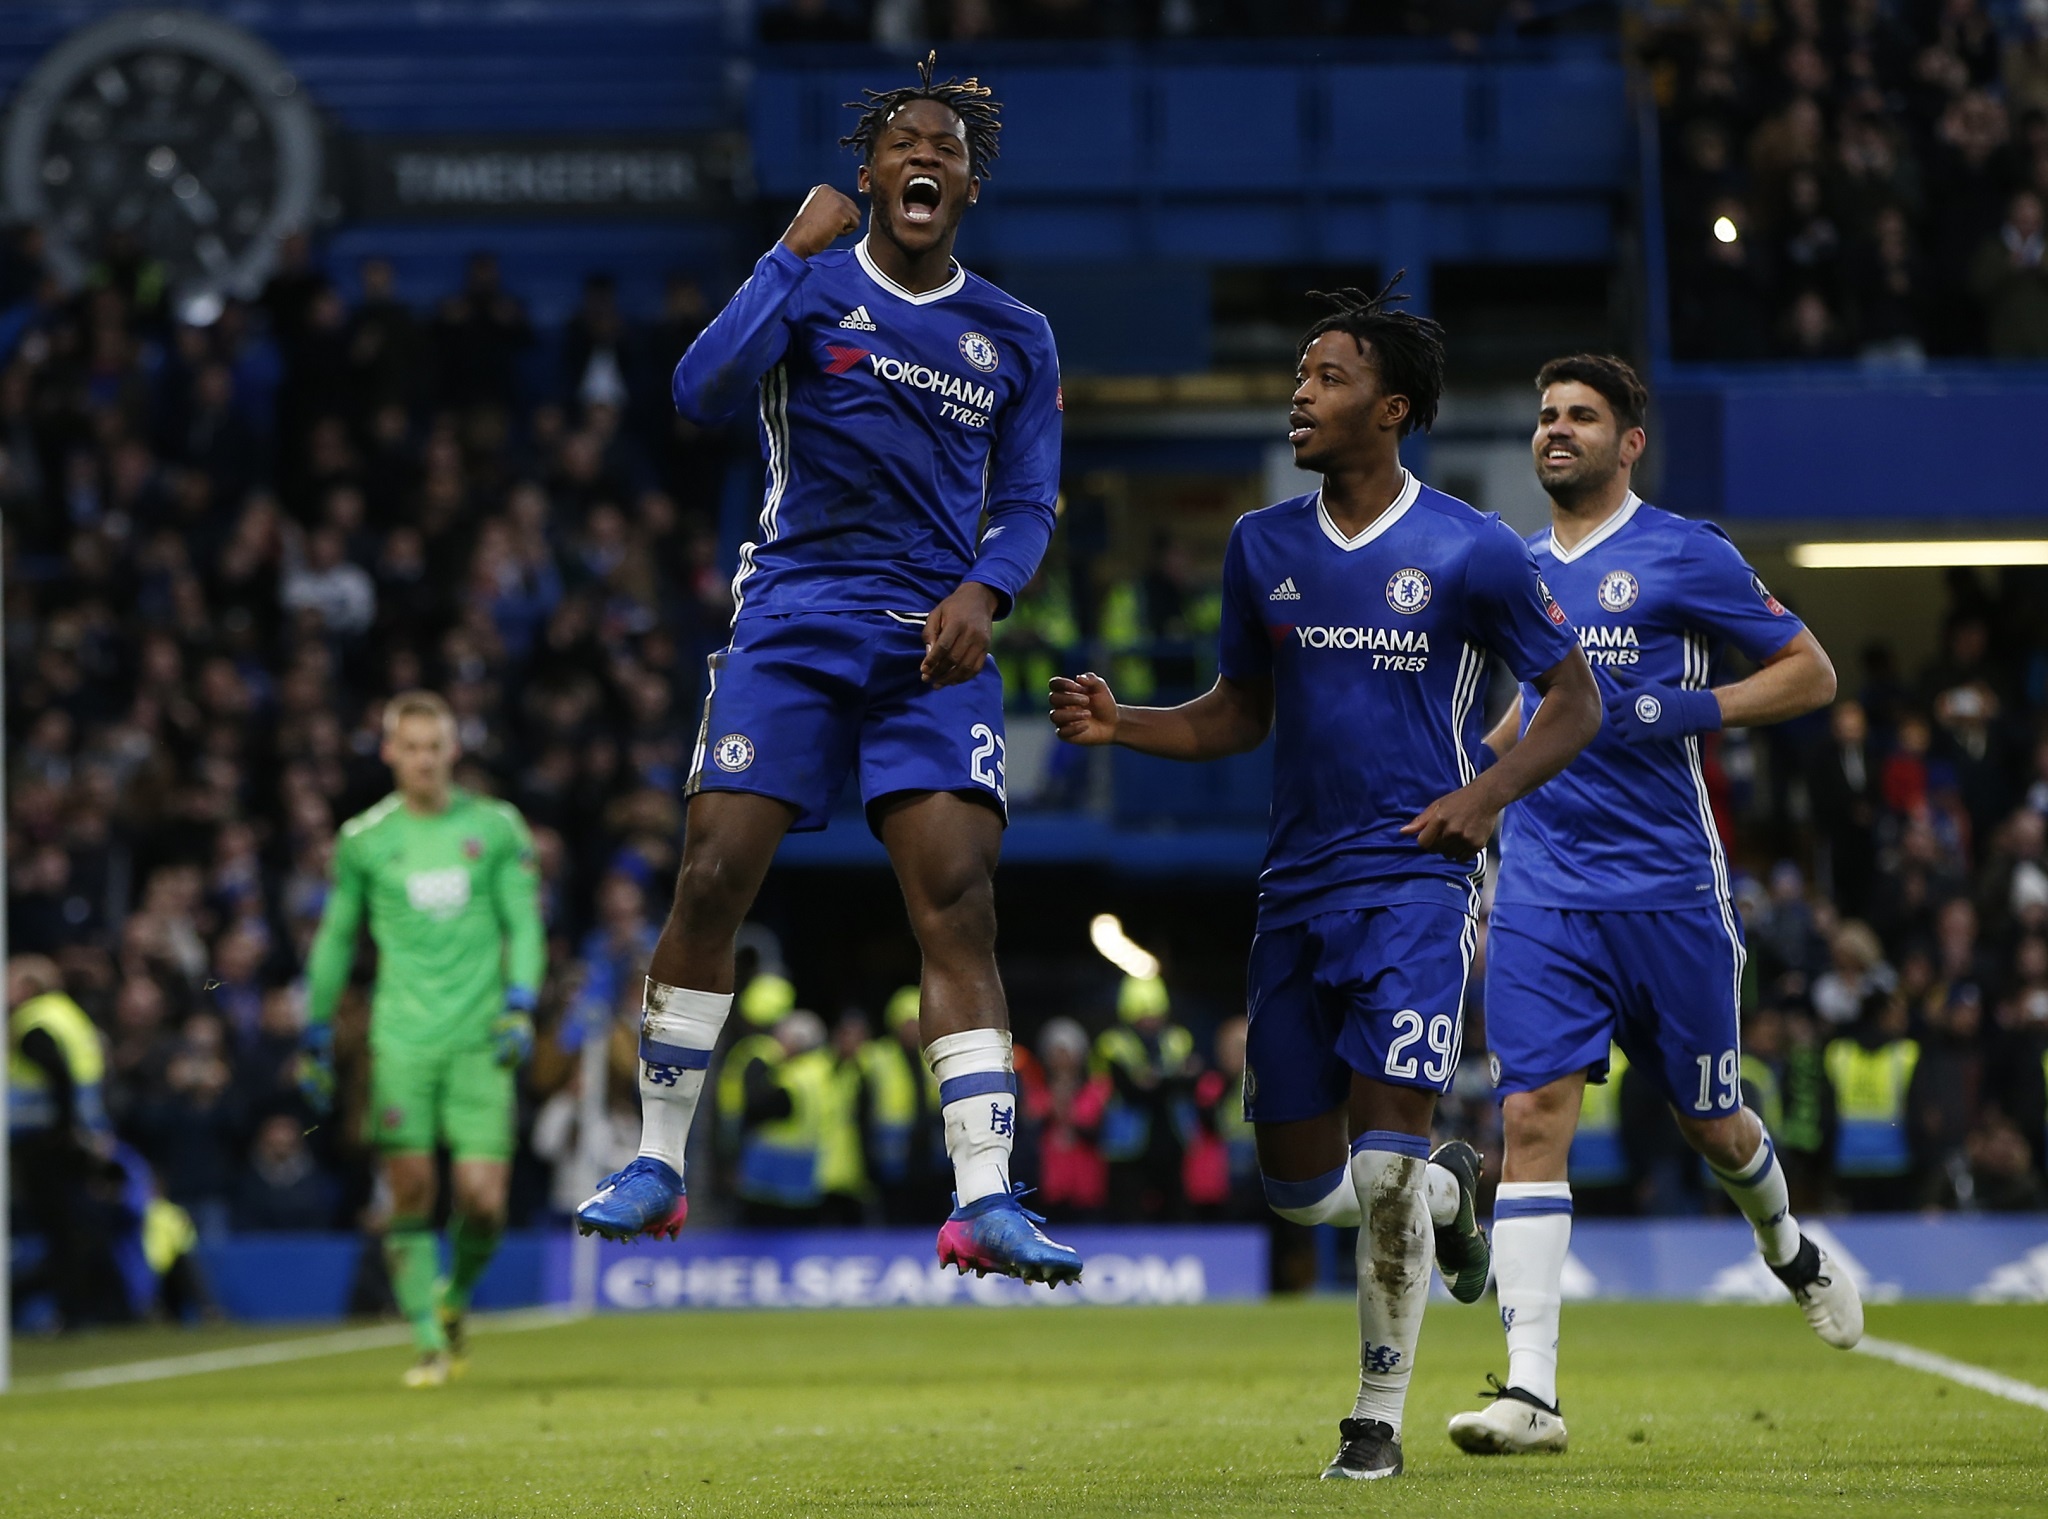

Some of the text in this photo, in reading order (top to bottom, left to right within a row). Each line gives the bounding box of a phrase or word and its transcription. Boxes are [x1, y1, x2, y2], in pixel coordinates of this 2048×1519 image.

[839, 320, 877, 331] adidas
[870, 354, 995, 412] YOKOHAMA
[939, 402, 989, 428] TYRES
[1396, 570, 1425, 581] CHELSEA
[1269, 591, 1301, 601] adidas
[1295, 626, 1429, 652] YOKOHAMA
[1372, 654, 1427, 672] TYRES
[1586, 649, 1640, 666] TYRES
[1384, 1009, 1453, 1082] 29
[1694, 1048, 1738, 1111] 19
